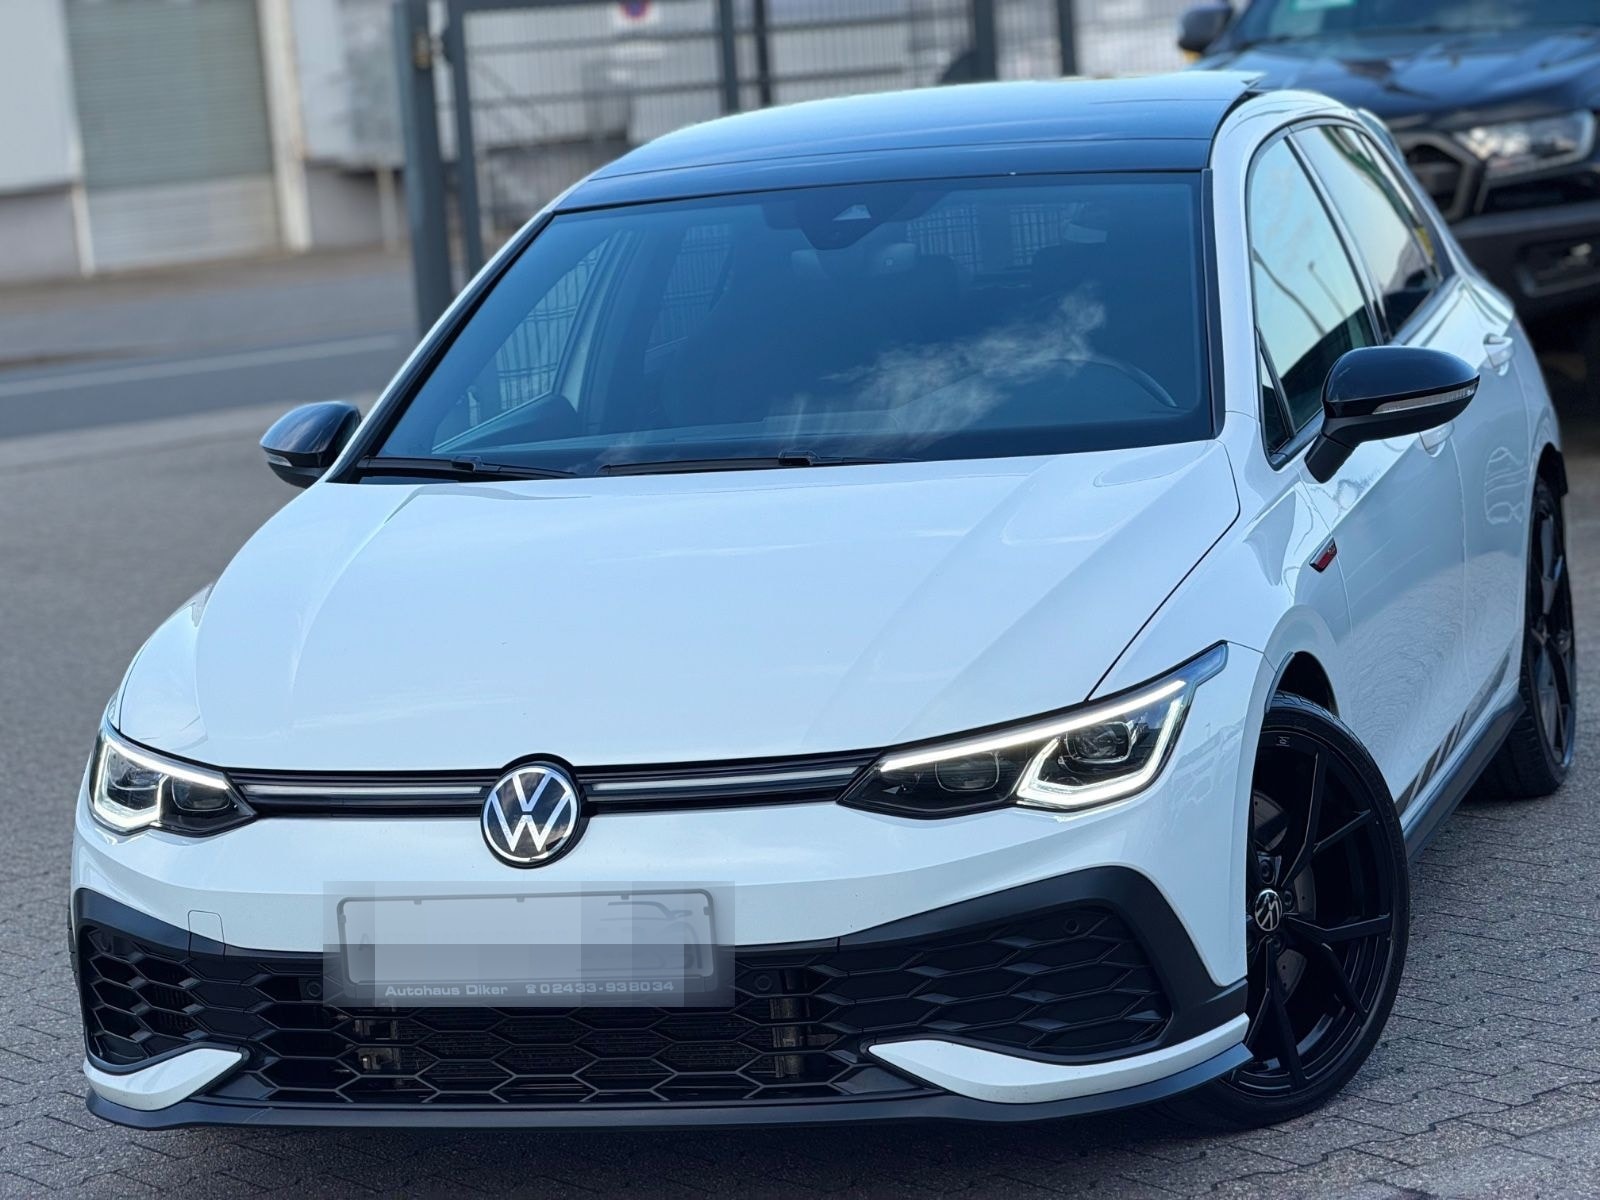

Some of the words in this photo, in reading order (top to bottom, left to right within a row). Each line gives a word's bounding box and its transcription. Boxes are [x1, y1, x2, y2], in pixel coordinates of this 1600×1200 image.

[483, 767, 578, 862] VW
[385, 984, 460, 997] Autohaus
[465, 983, 508, 996] Diker
